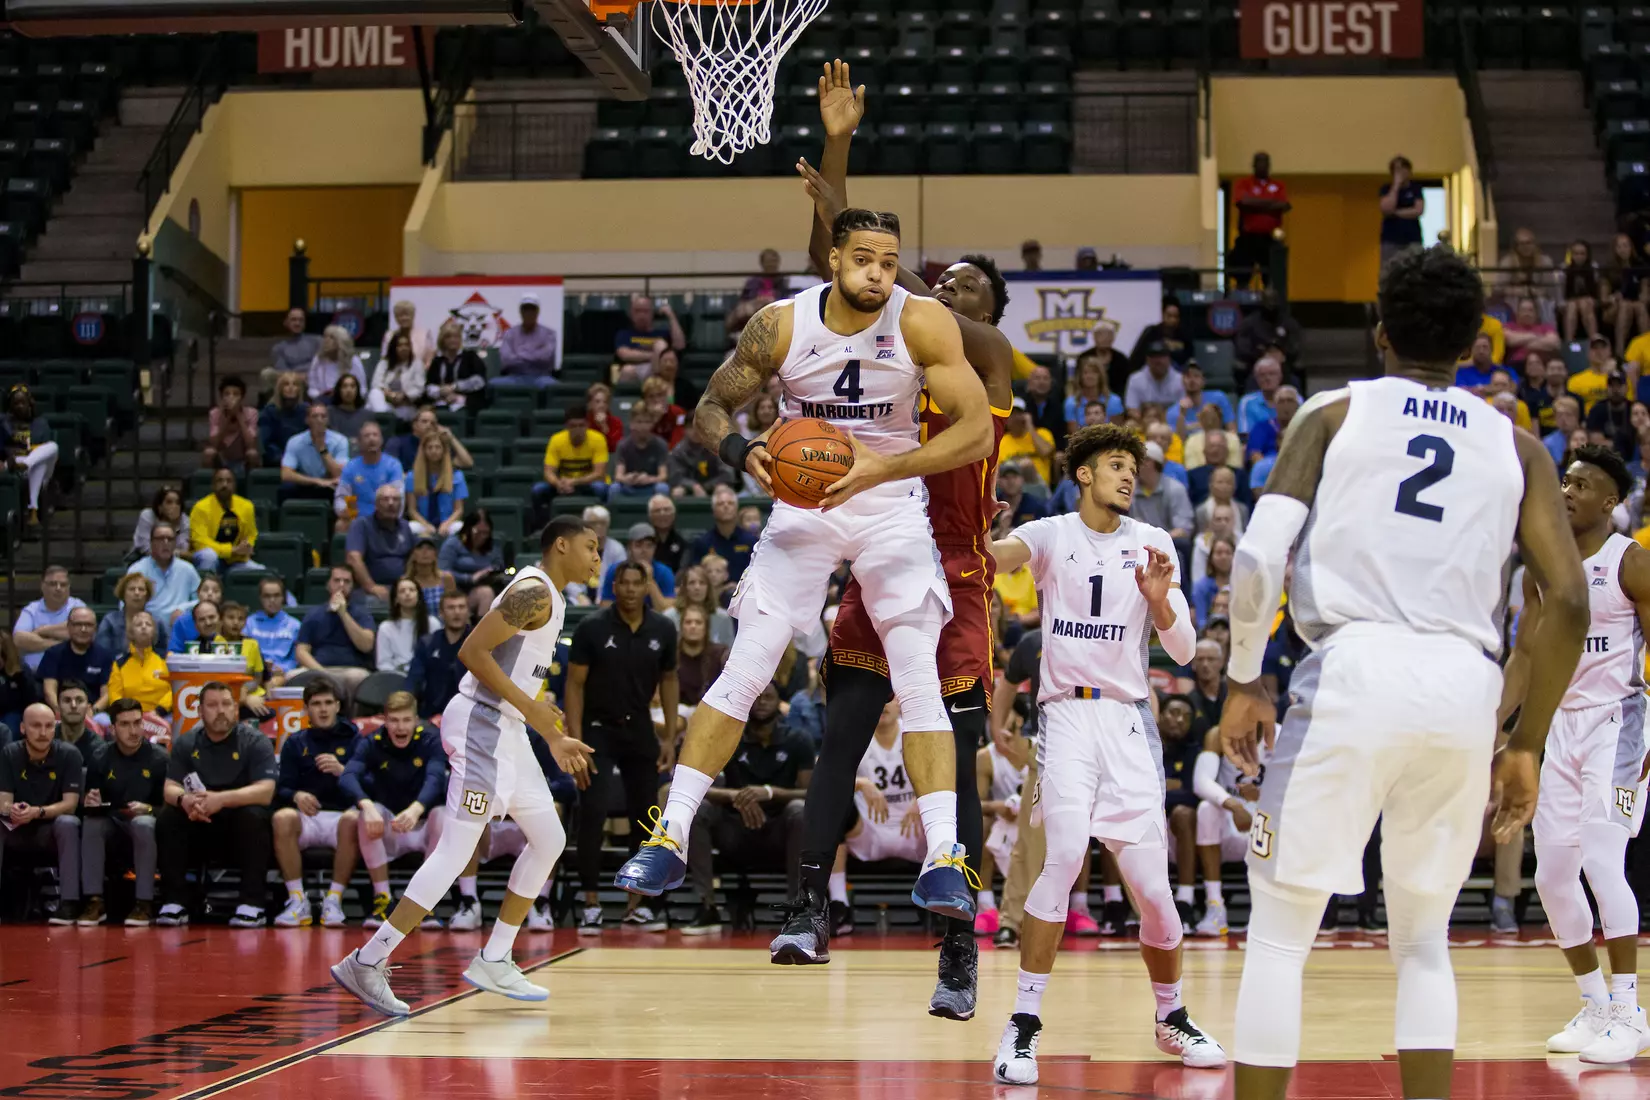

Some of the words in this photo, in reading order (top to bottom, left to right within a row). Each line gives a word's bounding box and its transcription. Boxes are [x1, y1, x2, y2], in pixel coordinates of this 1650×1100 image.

[1263, 2, 1400, 54] GUEST
[284, 25, 405, 68] HOME
[832, 359, 864, 404] 4
[800, 401, 894, 420] MARQUETTE
[1402, 397, 1468, 428] ANIM
[800, 447, 855, 470] SPALDING
[1394, 433, 1456, 524] 2
[1088, 574, 1104, 617] 1
[1052, 618, 1128, 642] MARQUETT
[1584, 636, 1609, 653] TTE
[283, 711, 303, 733] G
[874, 765, 906, 791] 34
[463, 790, 488, 815] MU
